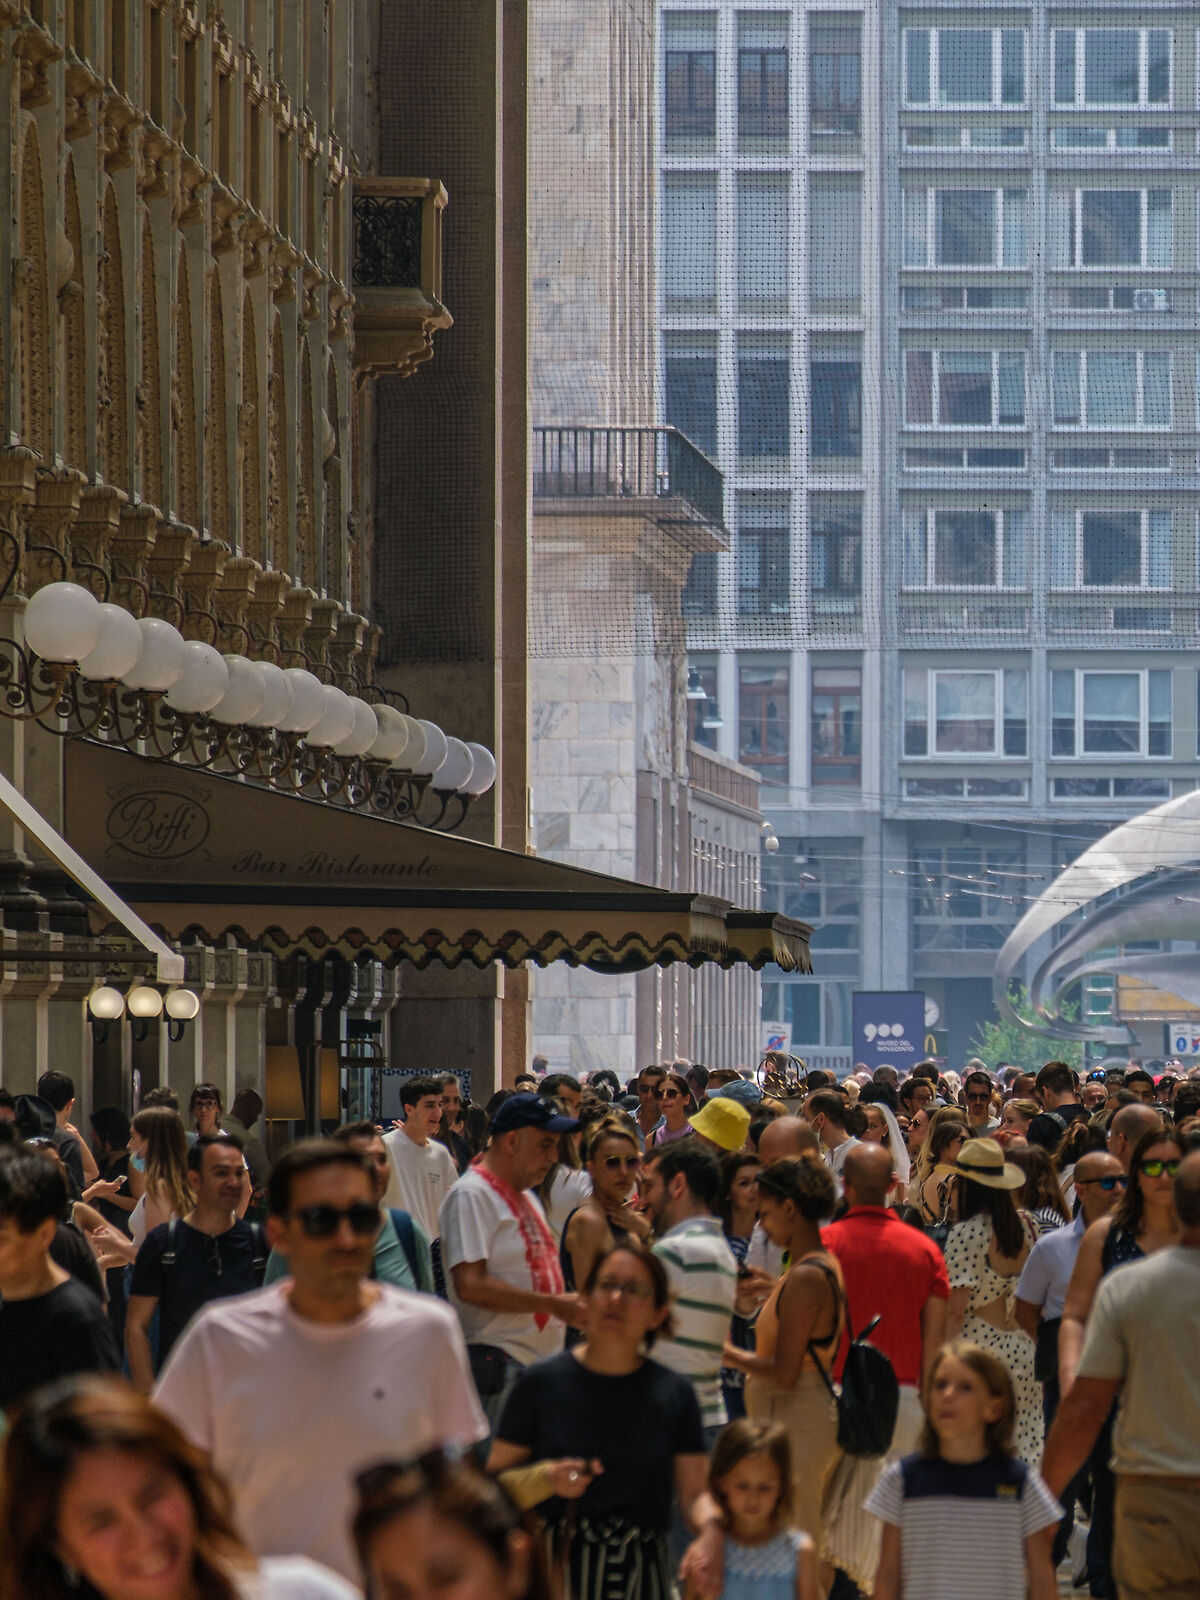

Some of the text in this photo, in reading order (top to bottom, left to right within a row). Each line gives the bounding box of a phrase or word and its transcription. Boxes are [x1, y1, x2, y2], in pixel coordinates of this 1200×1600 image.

[119, 797, 198, 855] Biffi
[231, 850, 440, 877] Bar Ristorante
